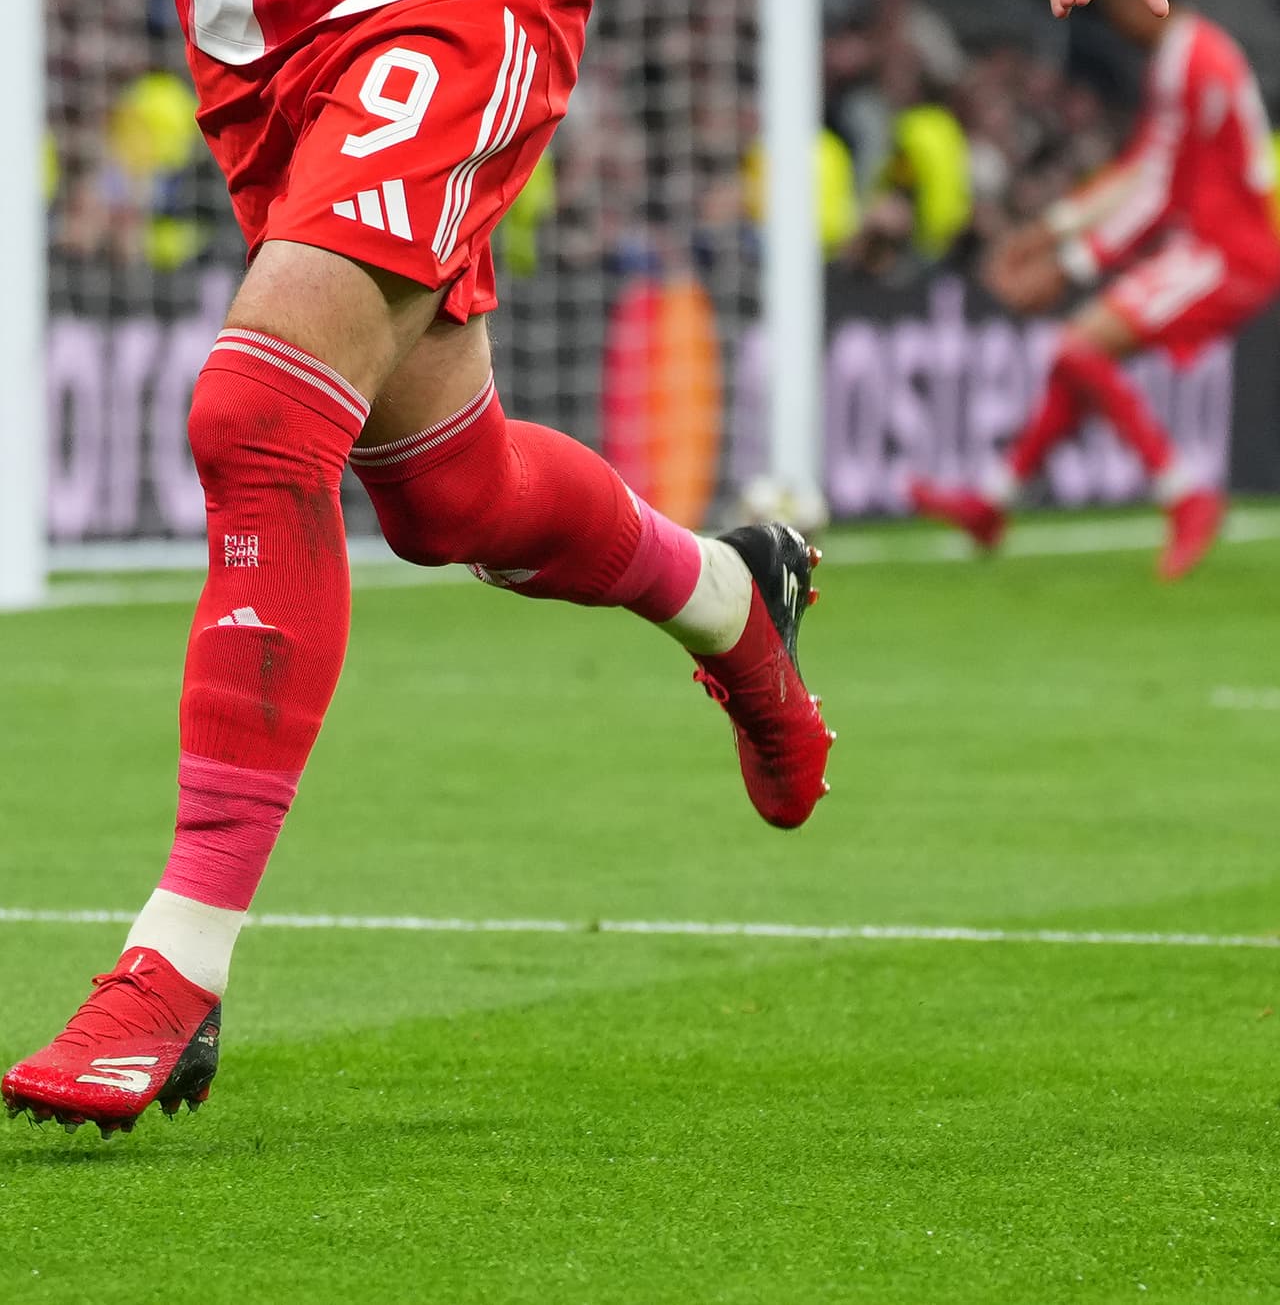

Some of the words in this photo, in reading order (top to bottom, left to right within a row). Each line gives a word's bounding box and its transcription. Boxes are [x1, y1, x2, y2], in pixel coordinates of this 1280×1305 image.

[339, 46, 441, 159] 9
[224, 534, 259, 546] MIA
[224, 545, 259, 557] SAN
[224, 556, 259, 567] MIA
